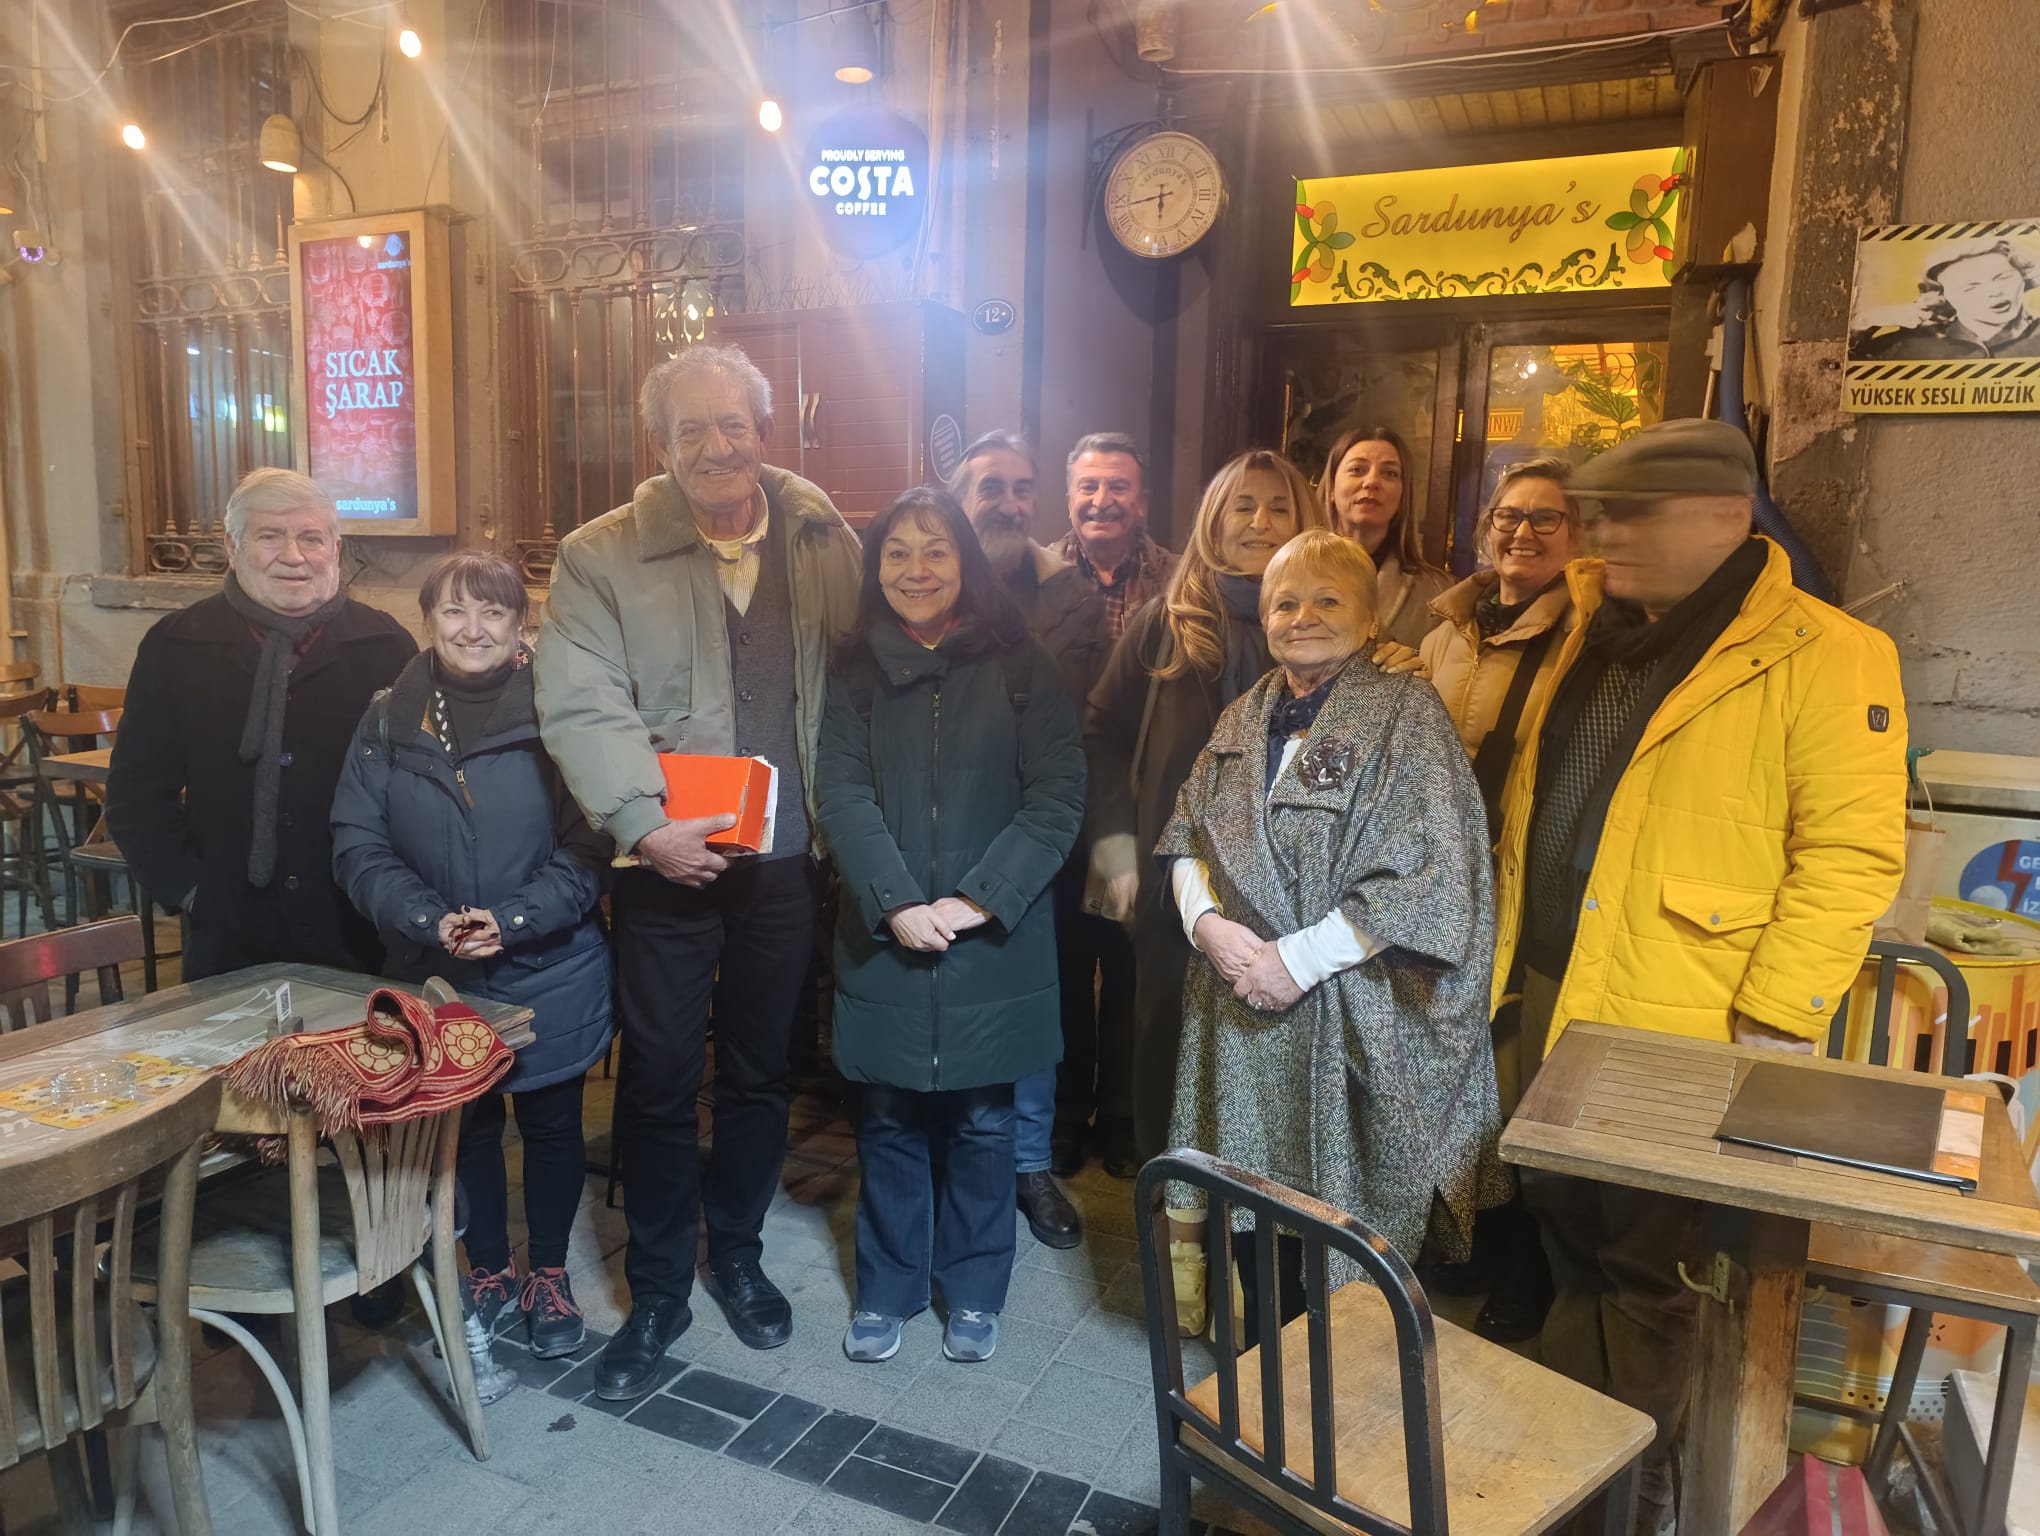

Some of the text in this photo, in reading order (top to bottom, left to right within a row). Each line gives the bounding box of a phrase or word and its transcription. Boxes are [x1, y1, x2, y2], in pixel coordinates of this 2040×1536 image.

[821, 149, 864, 161] PROUDLY
[809, 165, 915, 200] COSTA
[835, 202, 887, 215] COFFEE
[1361, 180, 1601, 244] Sardunya's
[984, 306, 1000, 323] 12
[326, 349, 402, 378] SICAK
[325, 381, 404, 419] ŞARAP
[1850, 380, 2036, 405] YÜKSEK SESLİ MÜZİK
[336, 497, 397, 514] sardunya's
